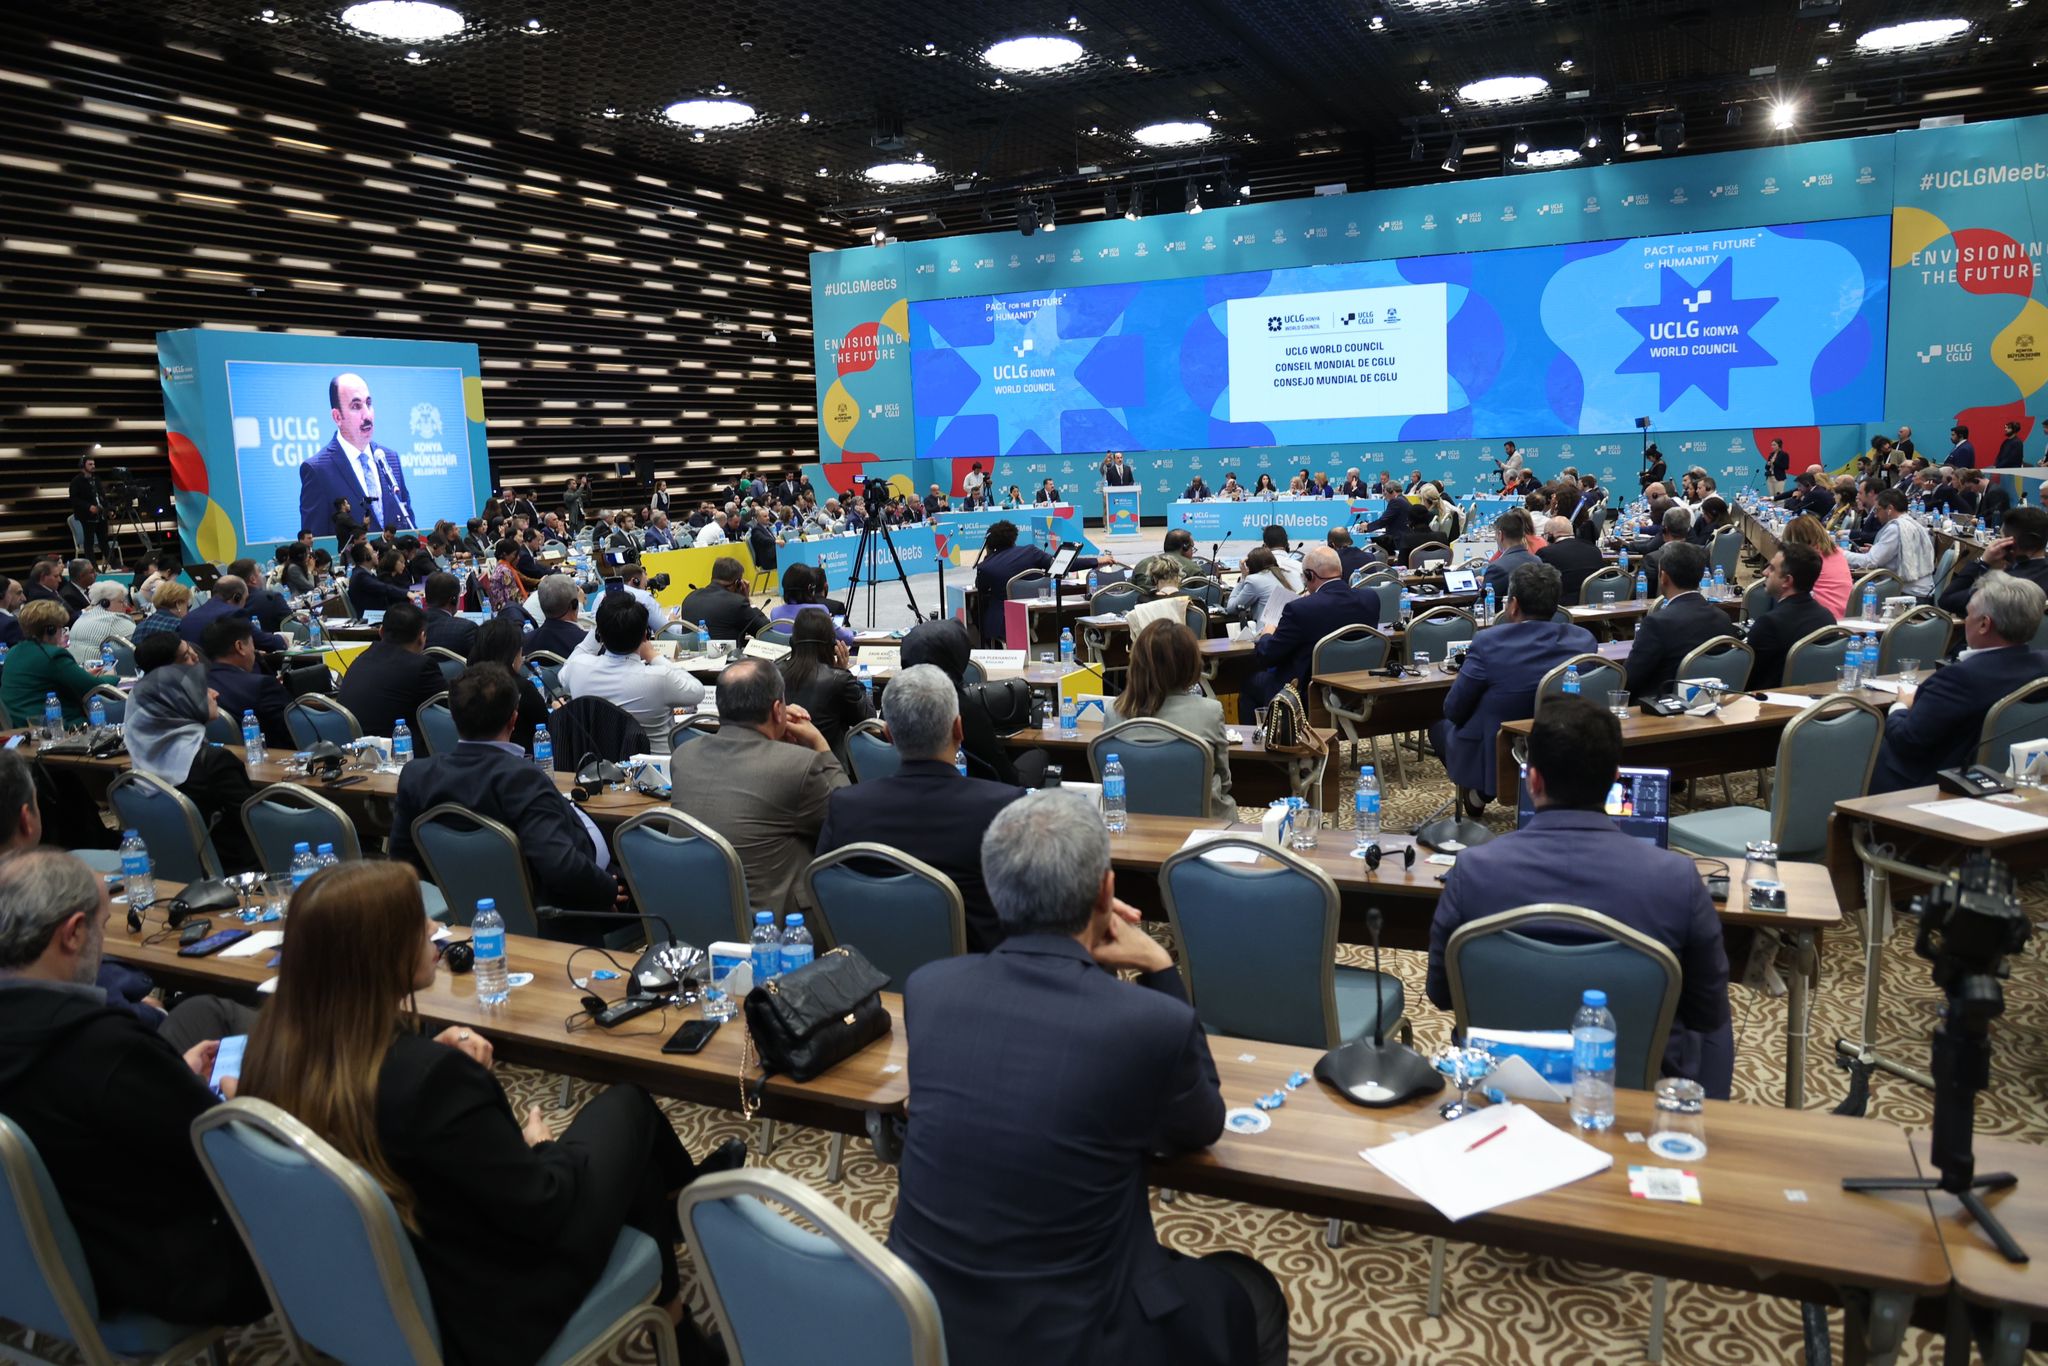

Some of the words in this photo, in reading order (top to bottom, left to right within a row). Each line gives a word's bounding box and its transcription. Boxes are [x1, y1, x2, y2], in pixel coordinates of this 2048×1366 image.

[1919, 162, 2048, 191] #UCLGMeet
[1644, 245, 1675, 256] PACT
[1695, 244, 1709, 252] THE
[1712, 238, 1756, 251] FUTURE
[1911, 241, 2048, 266] ENVISIONIN
[1644, 262, 1655, 270] OF
[1658, 255, 1719, 268] HUMANITY
[1921, 269, 1957, 285] THE
[1964, 263, 2042, 282] FUTURE
[824, 277, 897, 296] #UCLGMeets
[985, 302, 1006, 311] PACT
[1032, 297, 1063, 308] FUTURE
[995, 310, 1038, 321] HUMANITY
[1284, 314, 1305, 323] UCLG
[1649, 319, 1699, 341] UCLG
[1703, 325, 1739, 337] KONYA
[824, 332, 902, 351] ENVISIONING
[1285, 346, 1308, 356] UCLG
[1309, 344, 1343, 355] WORLD
[1344, 341, 1384, 353] COUNCIL
[1946, 343, 1972, 353] UCLG
[830, 353, 851, 364] THE
[853, 349, 895, 362] FUTURE
[1650, 345, 1689, 358] WORLD
[1691, 342, 1739, 356] COUNCIL
[1946, 352, 1972, 362] CGLU
[993, 363, 1028, 380] UCLG
[1030, 367, 1056, 378] KONYA
[1275, 361, 1312, 372] CONSEIL
[1314, 359, 1356, 370] MONDIAL
[1358, 358, 1369, 368] DE
[1371, 356, 1395, 367] CGLU
[1273, 376, 1314, 387] CONSEJO
[1316, 374, 1358, 385] MUNDIAL
[1360, 373, 1372, 383] DE
[1374, 372, 1398, 382] CGLU
[994, 384, 1022, 395] WORLD
[1023, 383, 1056, 393] COUNCIL
[884, 403, 900, 411] UCLG
[269, 416, 320, 441] UCLG
[413, 442, 443, 452] KONYA
[1242, 513, 1329, 528] #UCLGMeets
